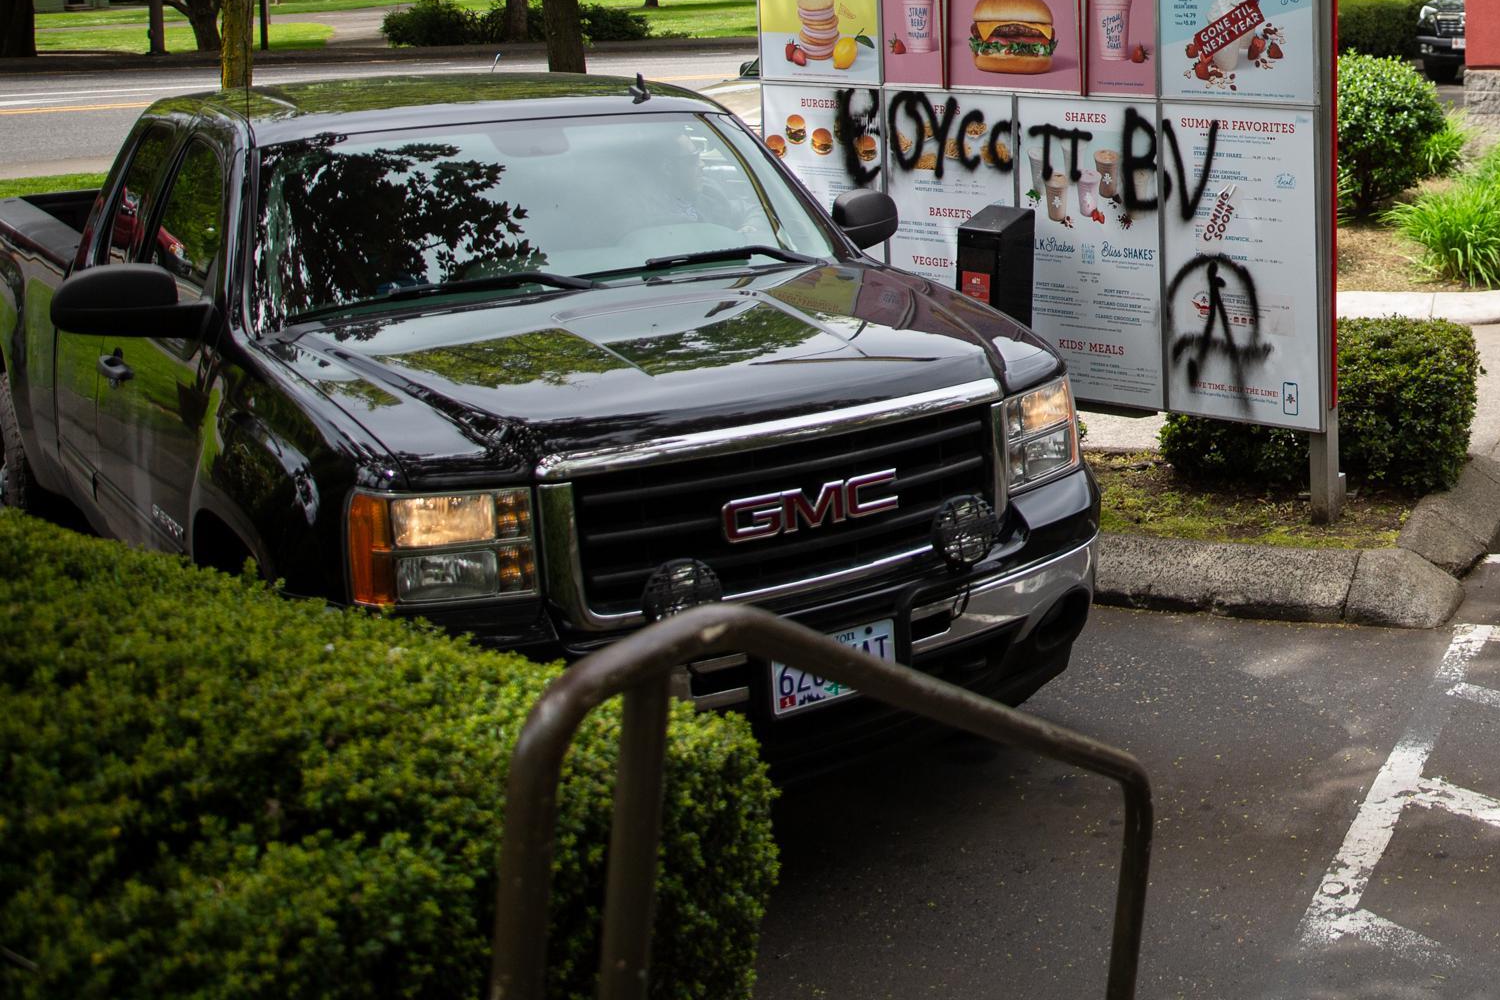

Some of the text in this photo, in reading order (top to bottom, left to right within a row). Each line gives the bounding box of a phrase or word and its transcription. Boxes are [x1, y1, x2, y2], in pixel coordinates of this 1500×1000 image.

[908, 7, 928, 18] STRAW
[1200, 17, 1231, 42] GONE
[1202, 12, 1260, 55] NEXT YEAR
[934, 104, 960, 115] FRS
[1065, 112, 1107, 124] SHAKES
[1232, 121, 1295, 134] FAVORITES
[1122, 107, 1218, 221] BV
[929, 207, 972, 219] BASKETS
[1203, 191, 1230, 242] COMING
[1213, 204, 1235, 241] SOON
[1045, 236, 1076, 253] Shakes
[1224, 235, 1249, 243] ANDWICH
[1101, 240, 1122, 258] Bliss
[912, 255, 949, 268] VEGGIE
[1059, 338, 1086, 351] KIDS'
[1089, 342, 1125, 356] MEALS
[1261, 388, 1279, 397] LINE!
[721, 467, 899, 544] GMC
